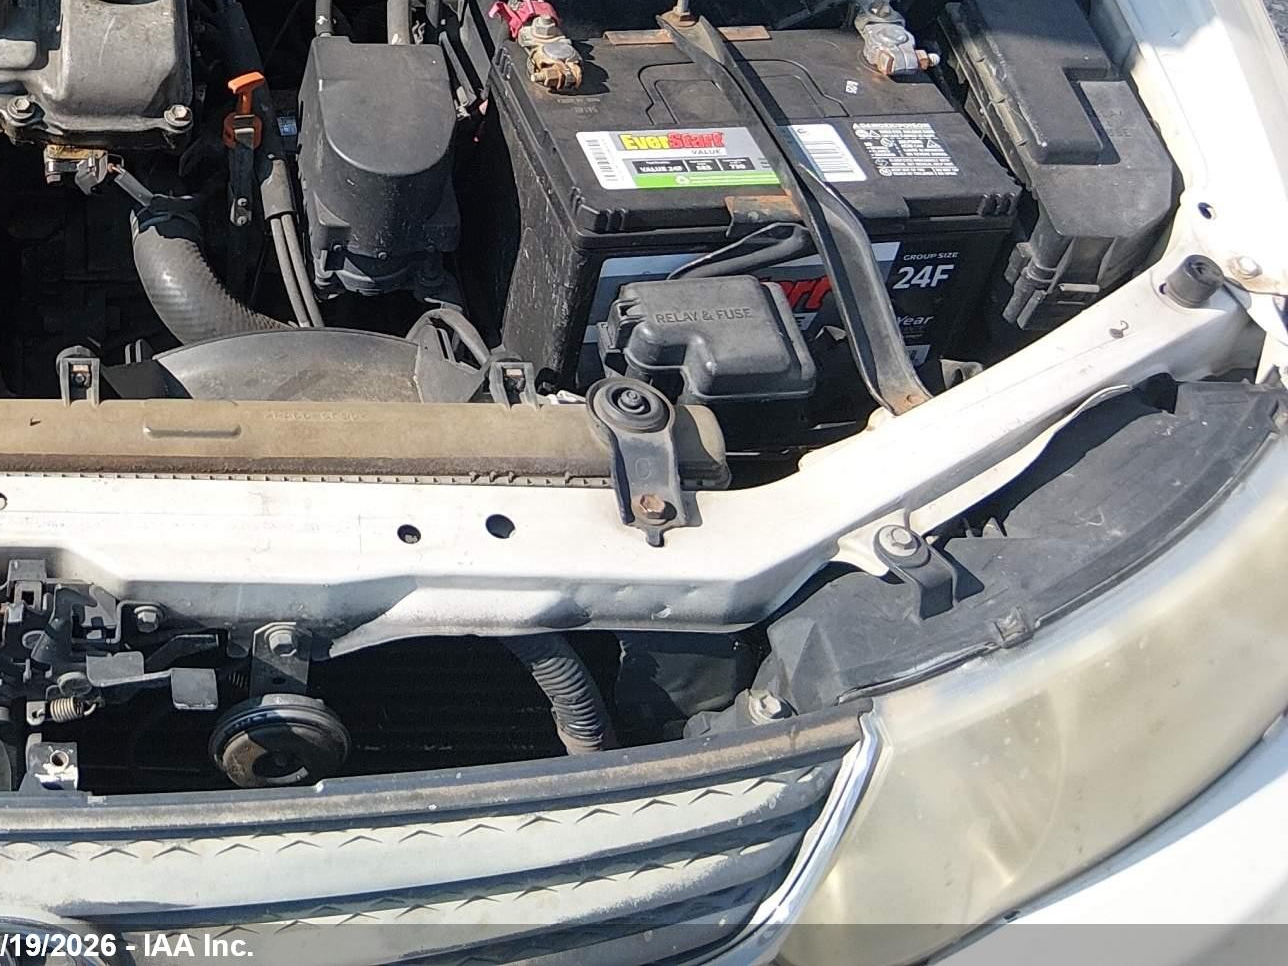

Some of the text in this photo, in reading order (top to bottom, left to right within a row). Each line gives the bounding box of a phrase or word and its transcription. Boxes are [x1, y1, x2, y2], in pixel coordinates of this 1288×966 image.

[619, 130, 726, 150] EverStart
[903, 251, 960, 261] GROUP SIZE
[892, 264, 954, 290] 24F
[655, 308, 753, 324] RELAY & FUSE
